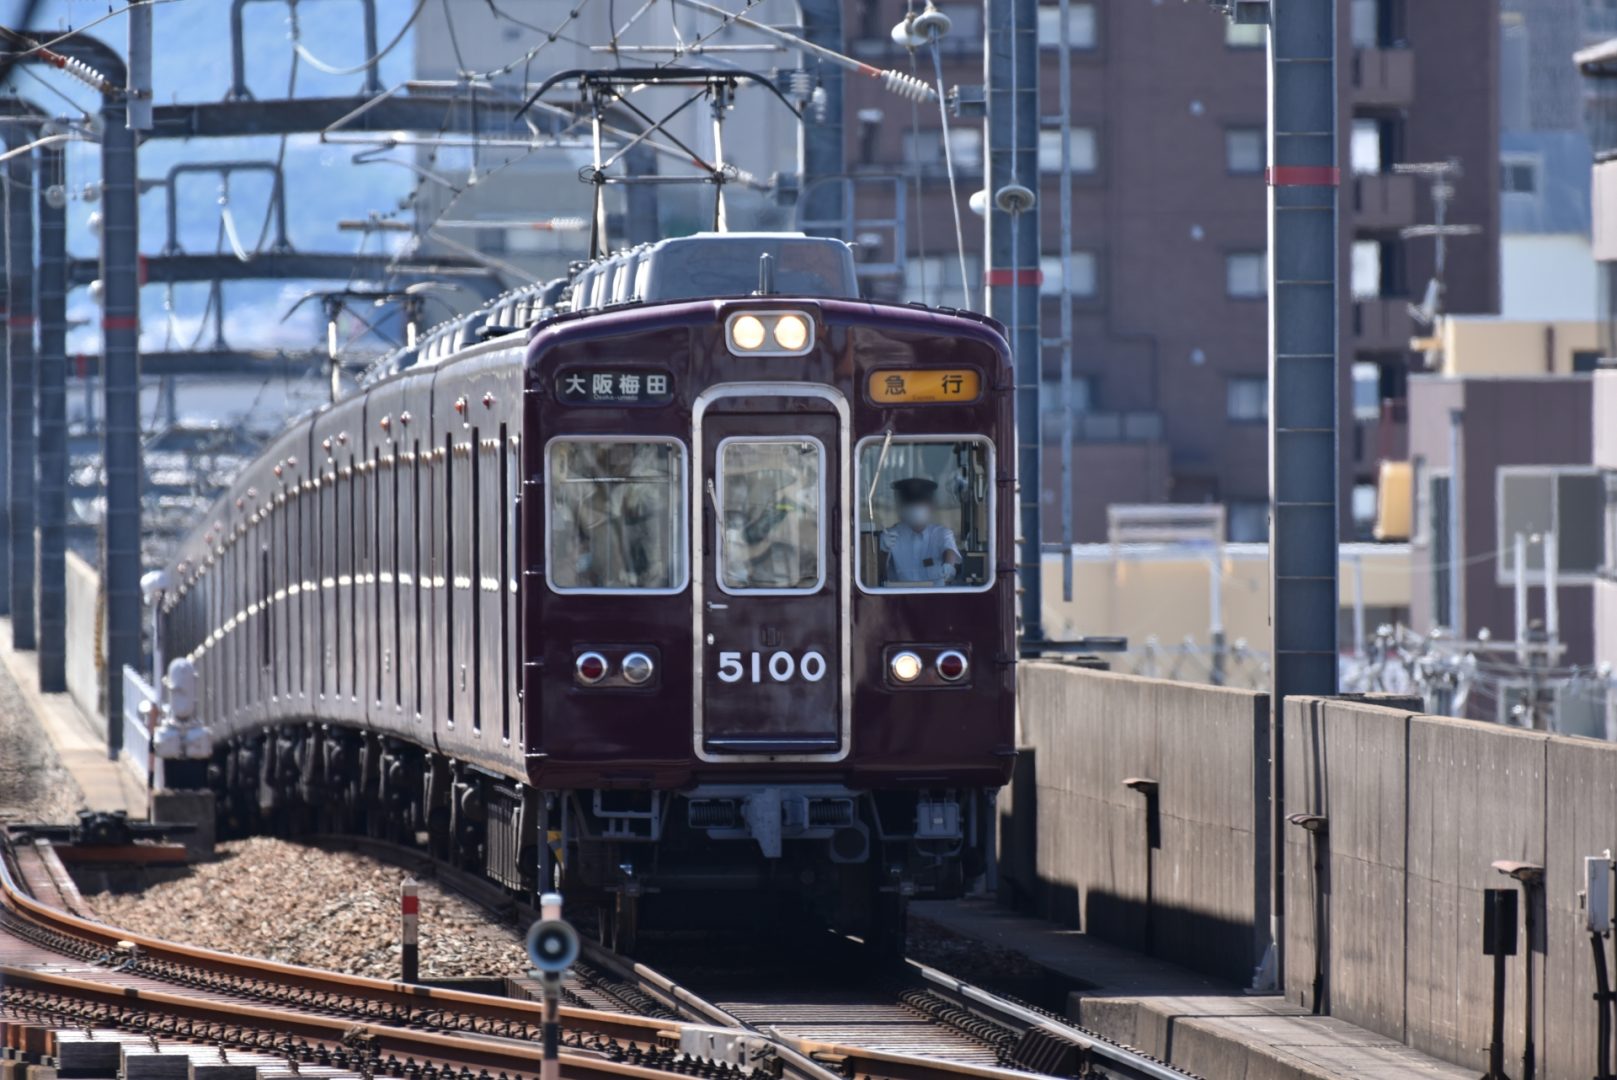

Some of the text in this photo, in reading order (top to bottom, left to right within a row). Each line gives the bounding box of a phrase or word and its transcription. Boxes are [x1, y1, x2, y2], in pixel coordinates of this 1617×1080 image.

[565, 373, 667, 394] 大阪梅田
[884, 374, 964, 395] 急行
[717, 650, 826, 683] 5100
